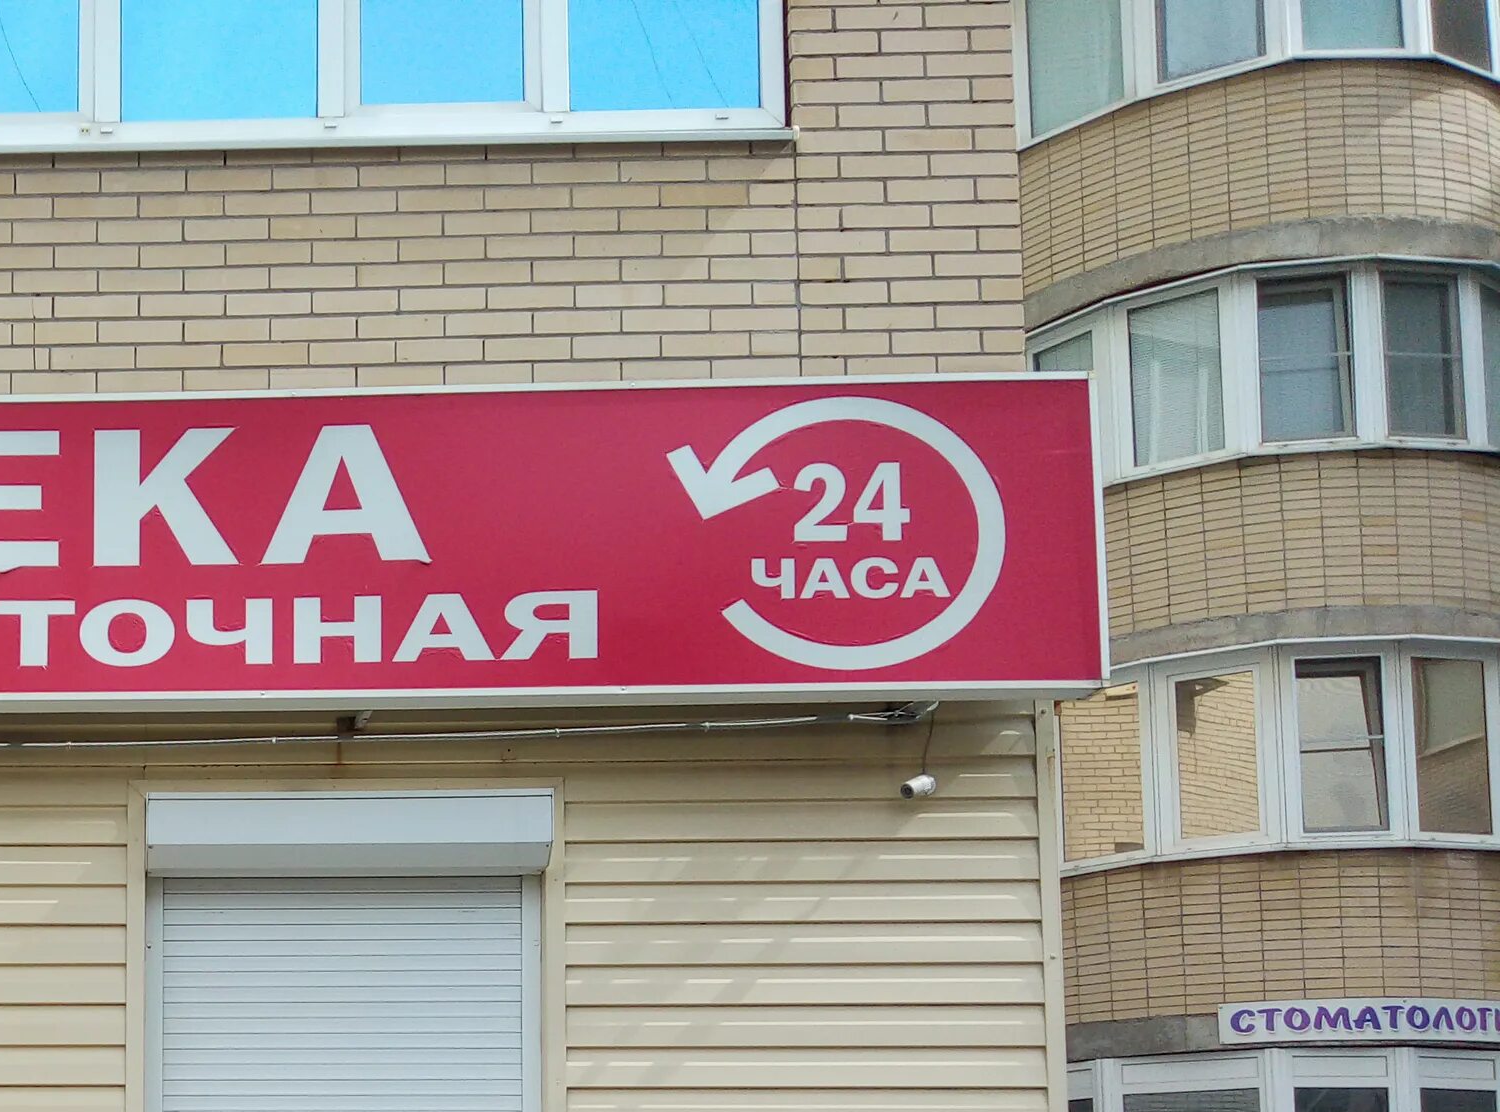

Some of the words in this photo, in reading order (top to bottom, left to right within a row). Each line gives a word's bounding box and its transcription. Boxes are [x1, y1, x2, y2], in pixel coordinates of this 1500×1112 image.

[793, 462, 910, 542] 24
[751, 557, 951, 599] ЧАСА
[1230, 1005, 1500, 1033] СТОМАТОЛОГ
